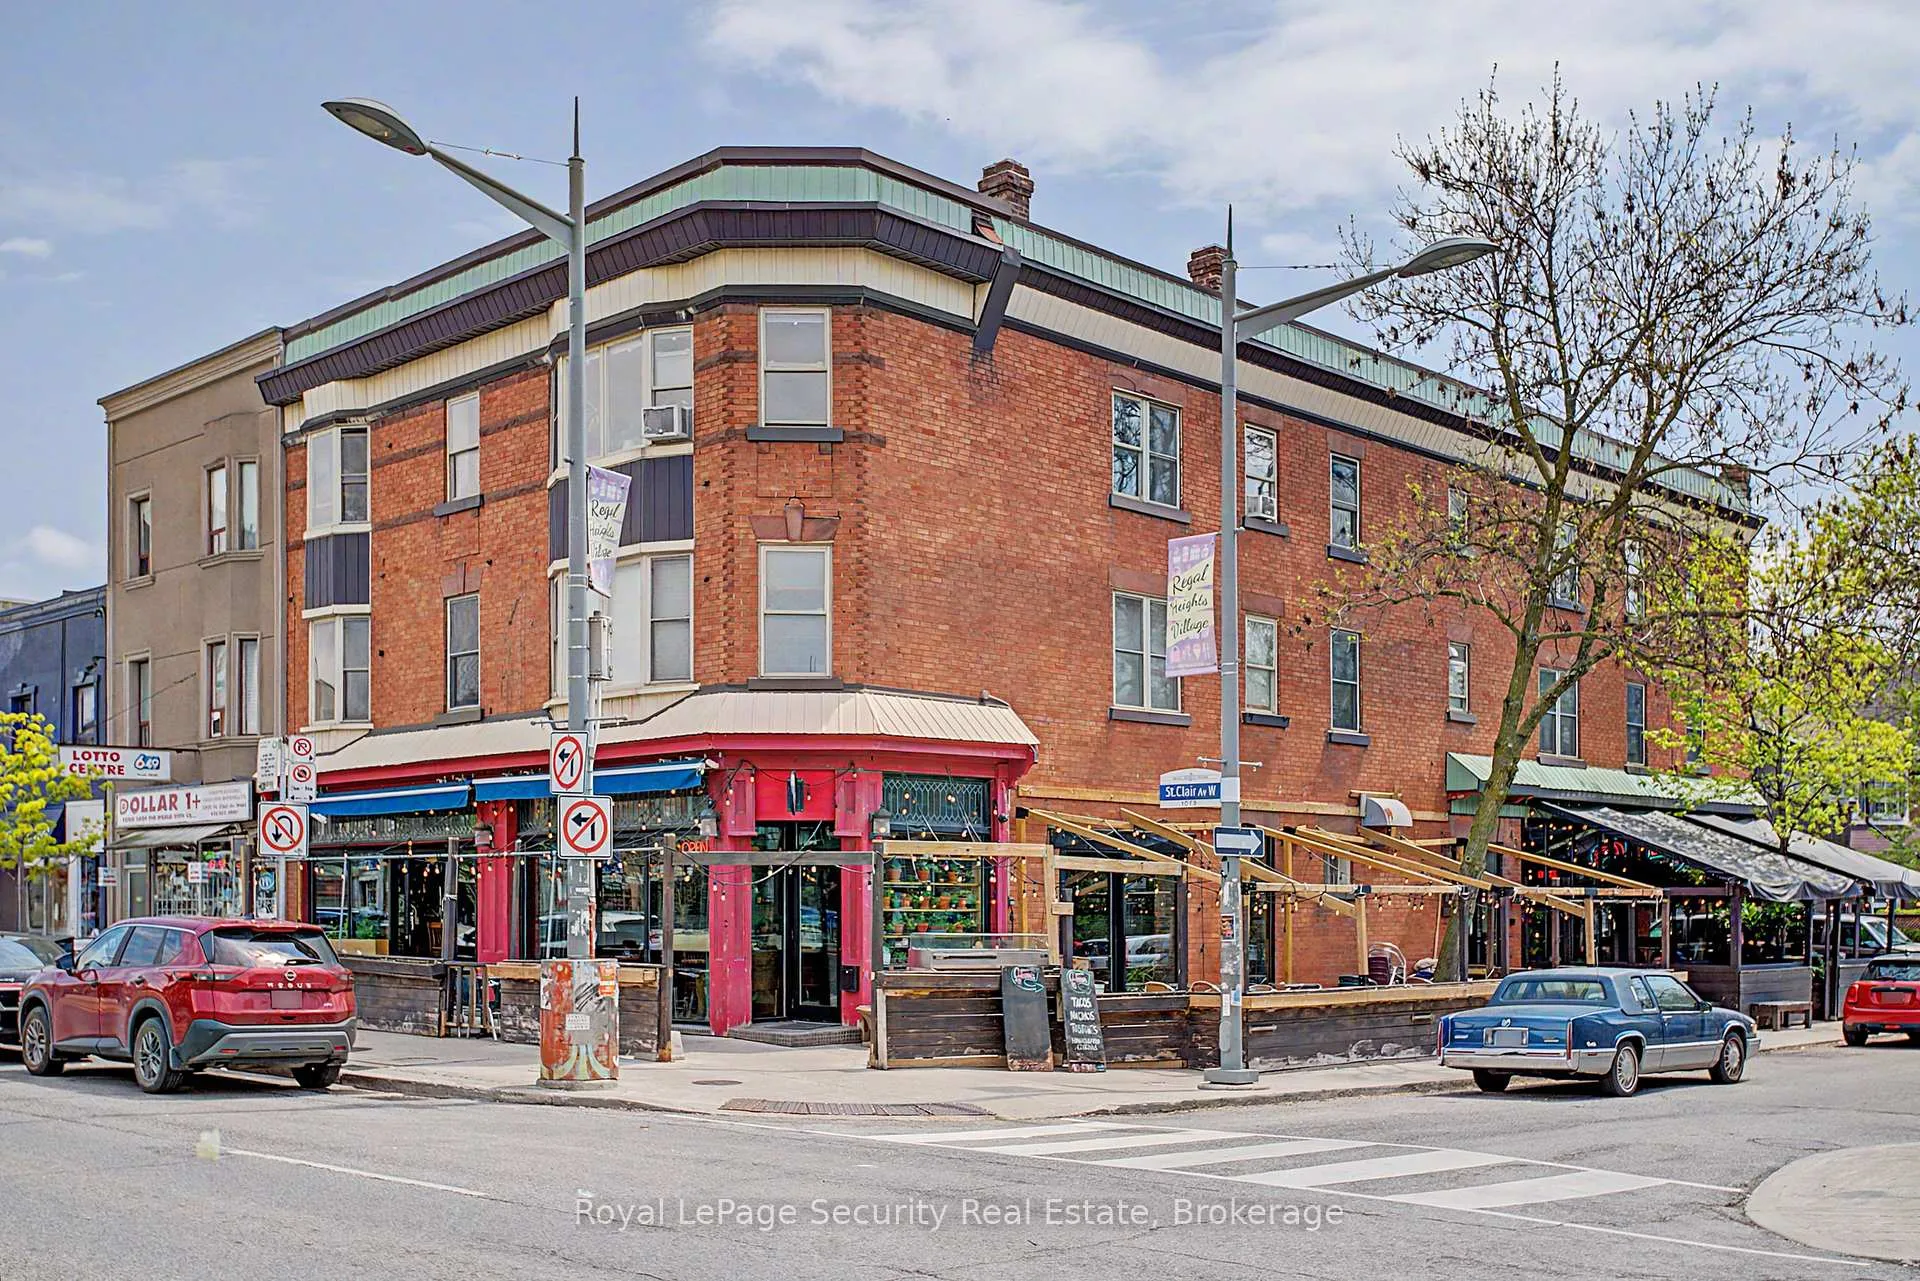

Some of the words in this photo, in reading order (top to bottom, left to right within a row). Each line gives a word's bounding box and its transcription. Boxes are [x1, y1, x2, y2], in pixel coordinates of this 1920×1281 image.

[1172, 563, 1209, 595] Regal
[1169, 592, 1208, 615] Heights
[1171, 618, 1209, 640] Village
[72, 750, 121, 762] LOTTO
[1197, 787, 1207, 797] Av
[1208, 785, 1217, 796] W
[119, 792, 178, 815] DOLLAR
[185, 792, 201, 810] 1+
[681, 841, 708, 852] OPEN
[1069, 996, 1093, 1008] TACOS
